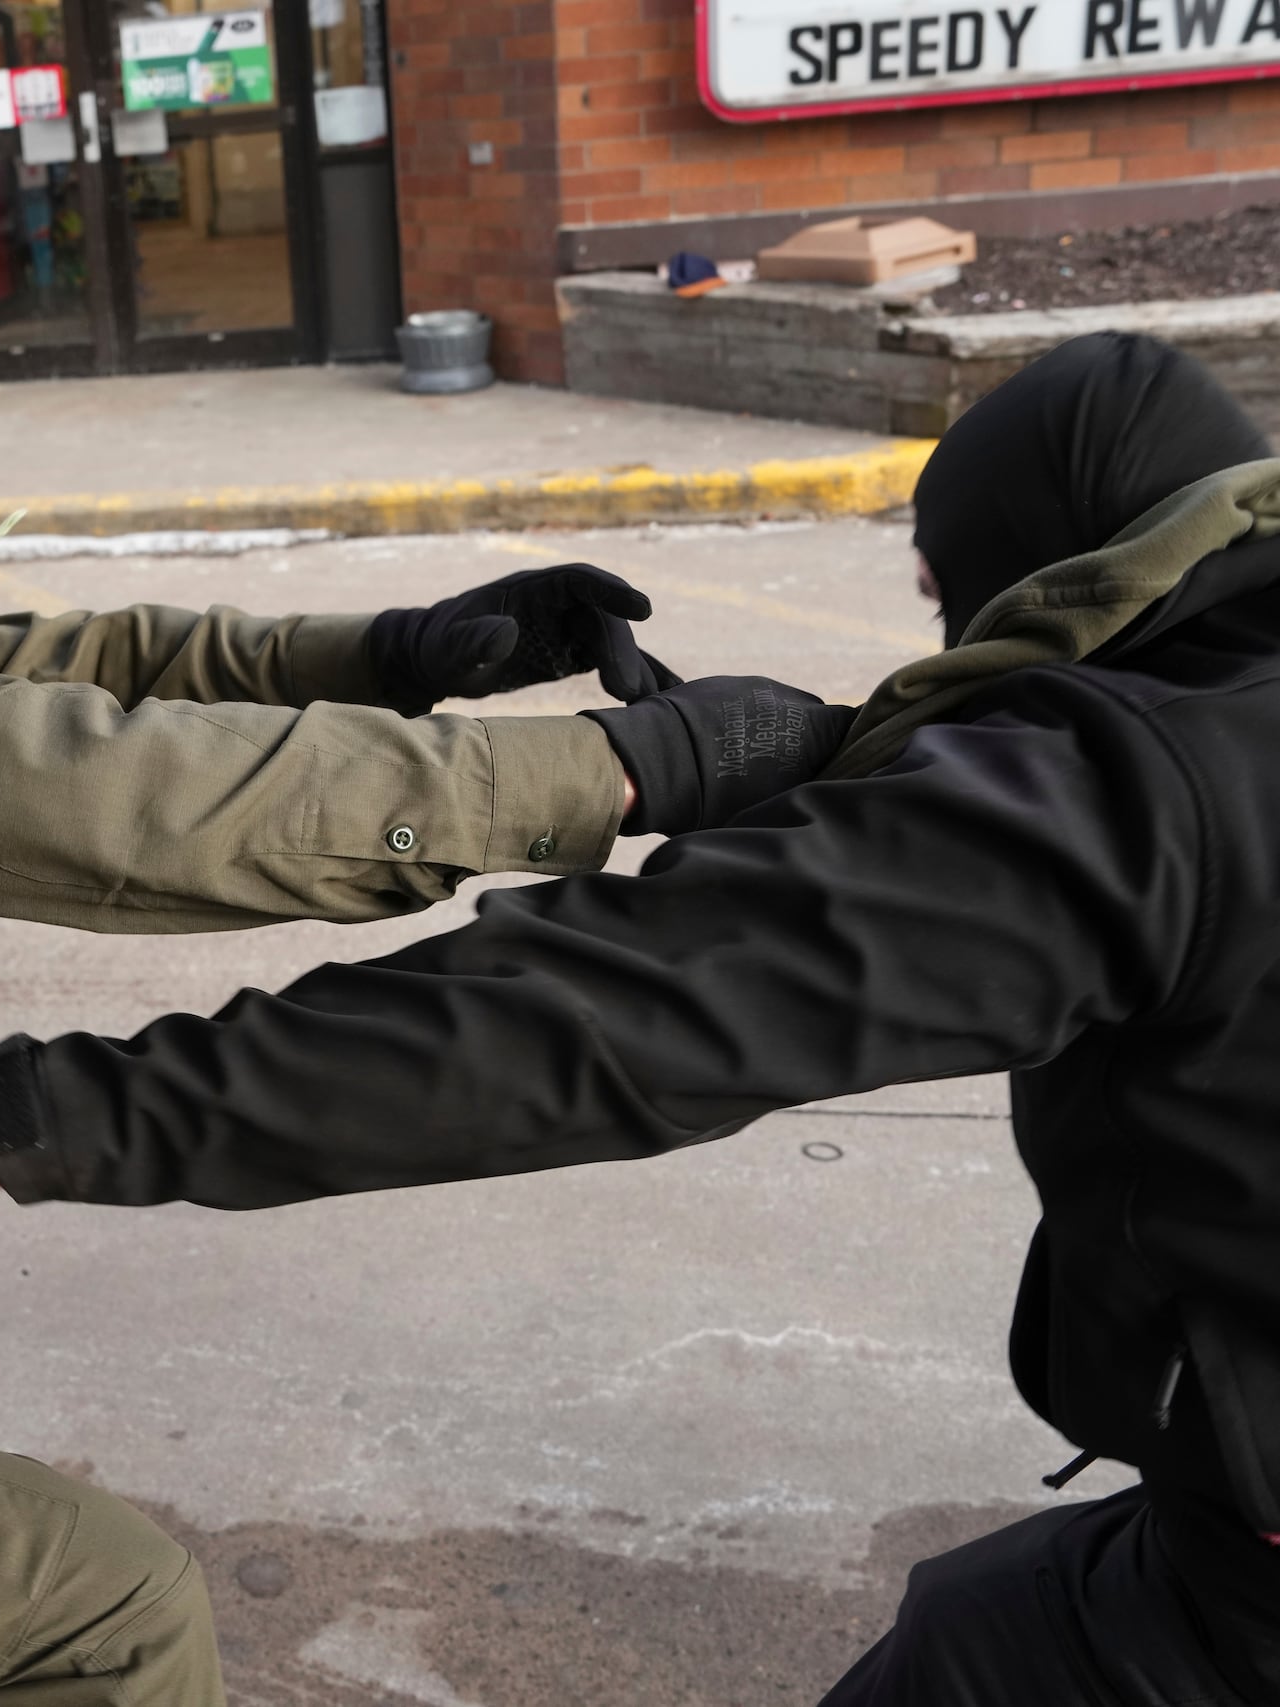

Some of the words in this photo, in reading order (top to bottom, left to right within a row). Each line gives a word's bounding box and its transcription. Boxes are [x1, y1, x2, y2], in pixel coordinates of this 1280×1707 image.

[788, 6, 1037, 86] SPEEDY
[714, 699, 746, 779] Mechanix
[745, 688, 778, 760] Mechanix
